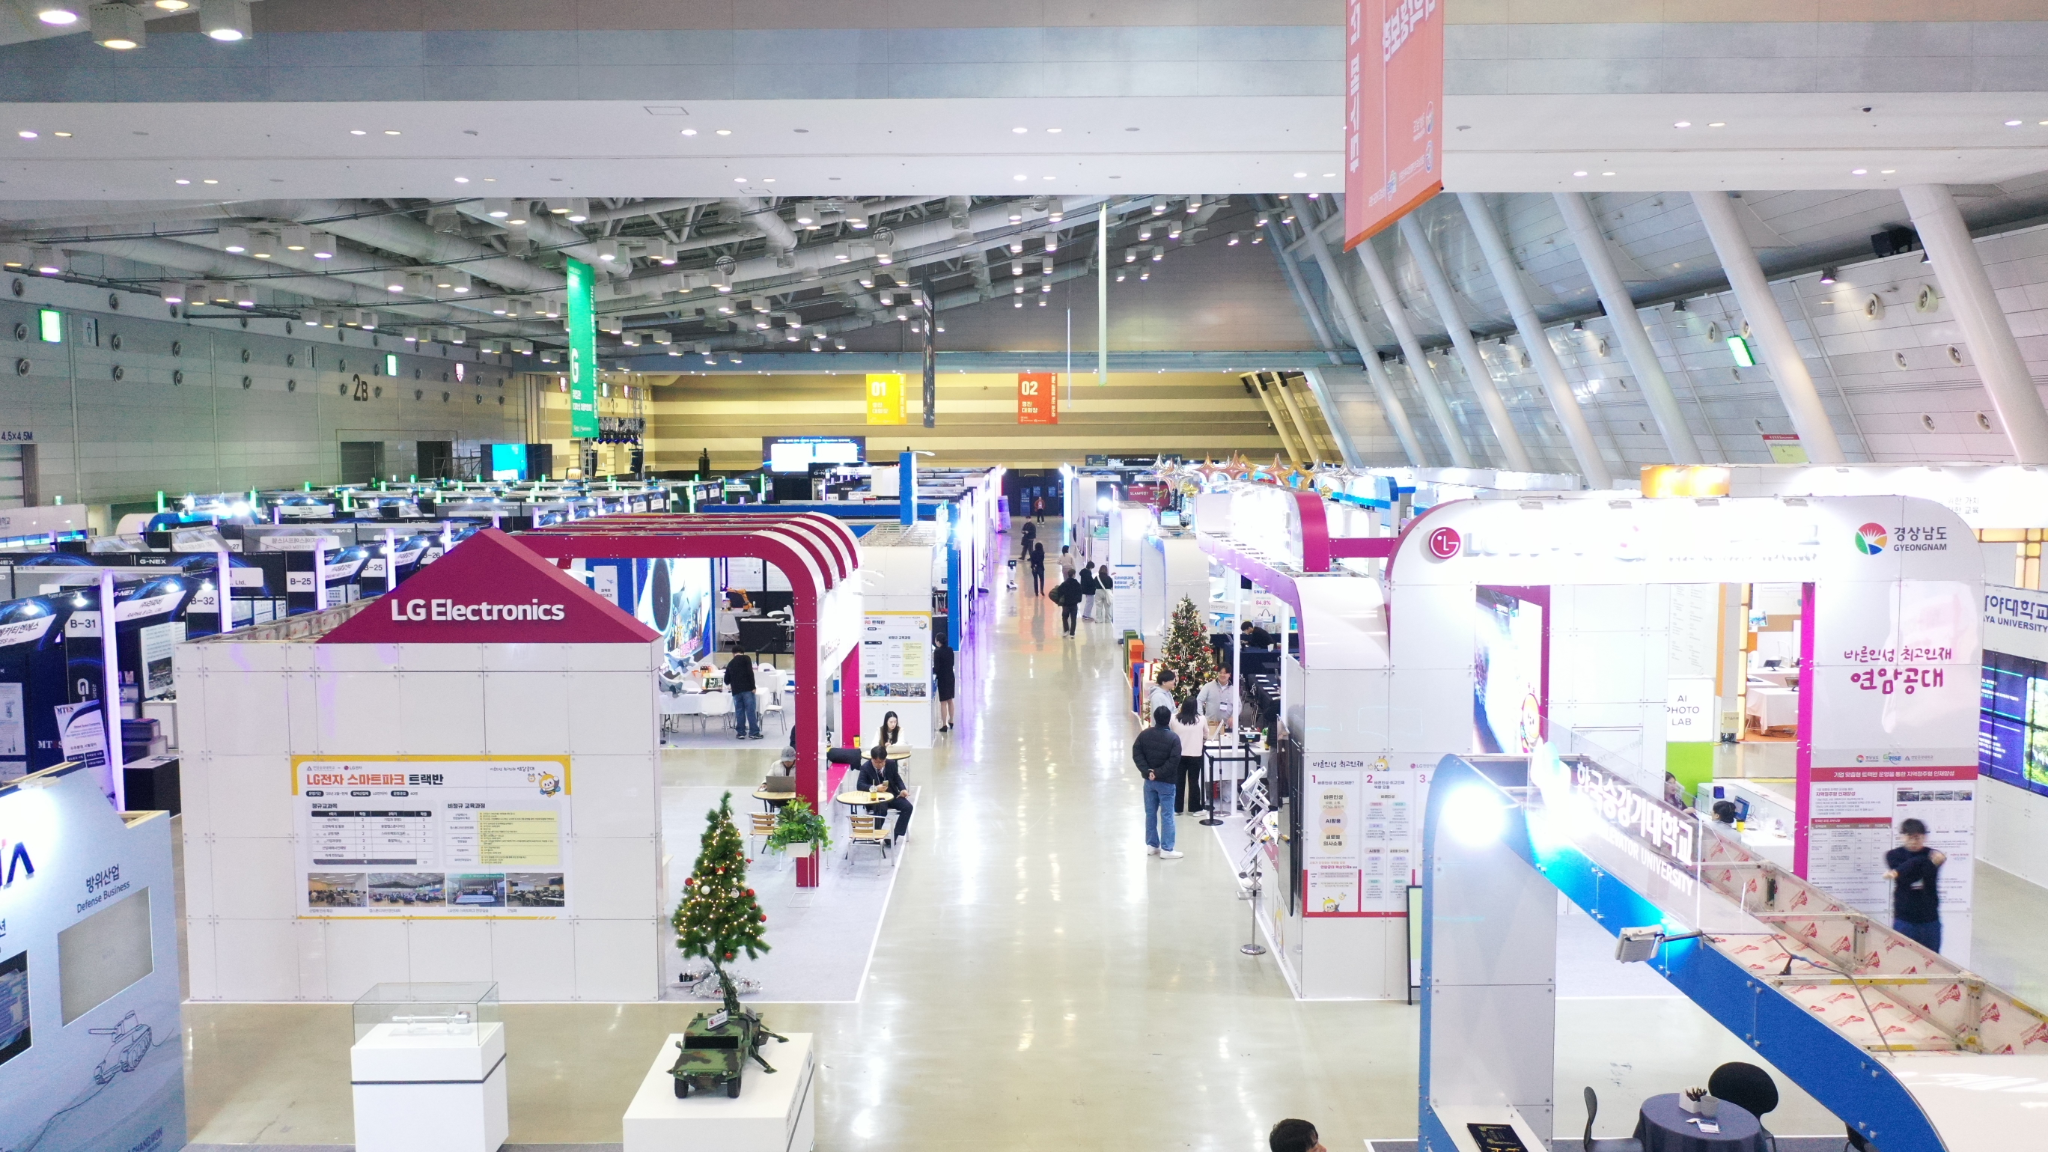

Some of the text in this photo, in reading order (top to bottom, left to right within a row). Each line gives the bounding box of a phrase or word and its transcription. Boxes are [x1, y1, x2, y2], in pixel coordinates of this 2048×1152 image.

[571, 348, 580, 384] G
[353, 374, 369, 401] 2B
[872, 382, 886, 396] 01
[1022, 381, 1038, 396] 02
[1894, 526, 1948, 542] 경상남도
[1894, 544, 1948, 552] GYEONGNAM
[290, 578, 312, 586] B-25
[391, 598, 566, 621] LG Electronics
[70, 618, 97, 630] B-31
[1998, 617, 2048, 632] UNIVERSITY
[1844, 646, 1952, 663] 바른인성 최고인재
[1850, 668, 1944, 694] 연암공대
[1671, 718, 1692, 726] LAB
[306, 774, 444, 786] LG전자 스마트파크 트랙반
[1312, 774, 1316, 784] 1
[1366, 774, 1373, 784] 2
[1420, 774, 1426, 783] 3
[86, 864, 120, 893] 방위산업
[76, 881, 130, 914] Defense Business
